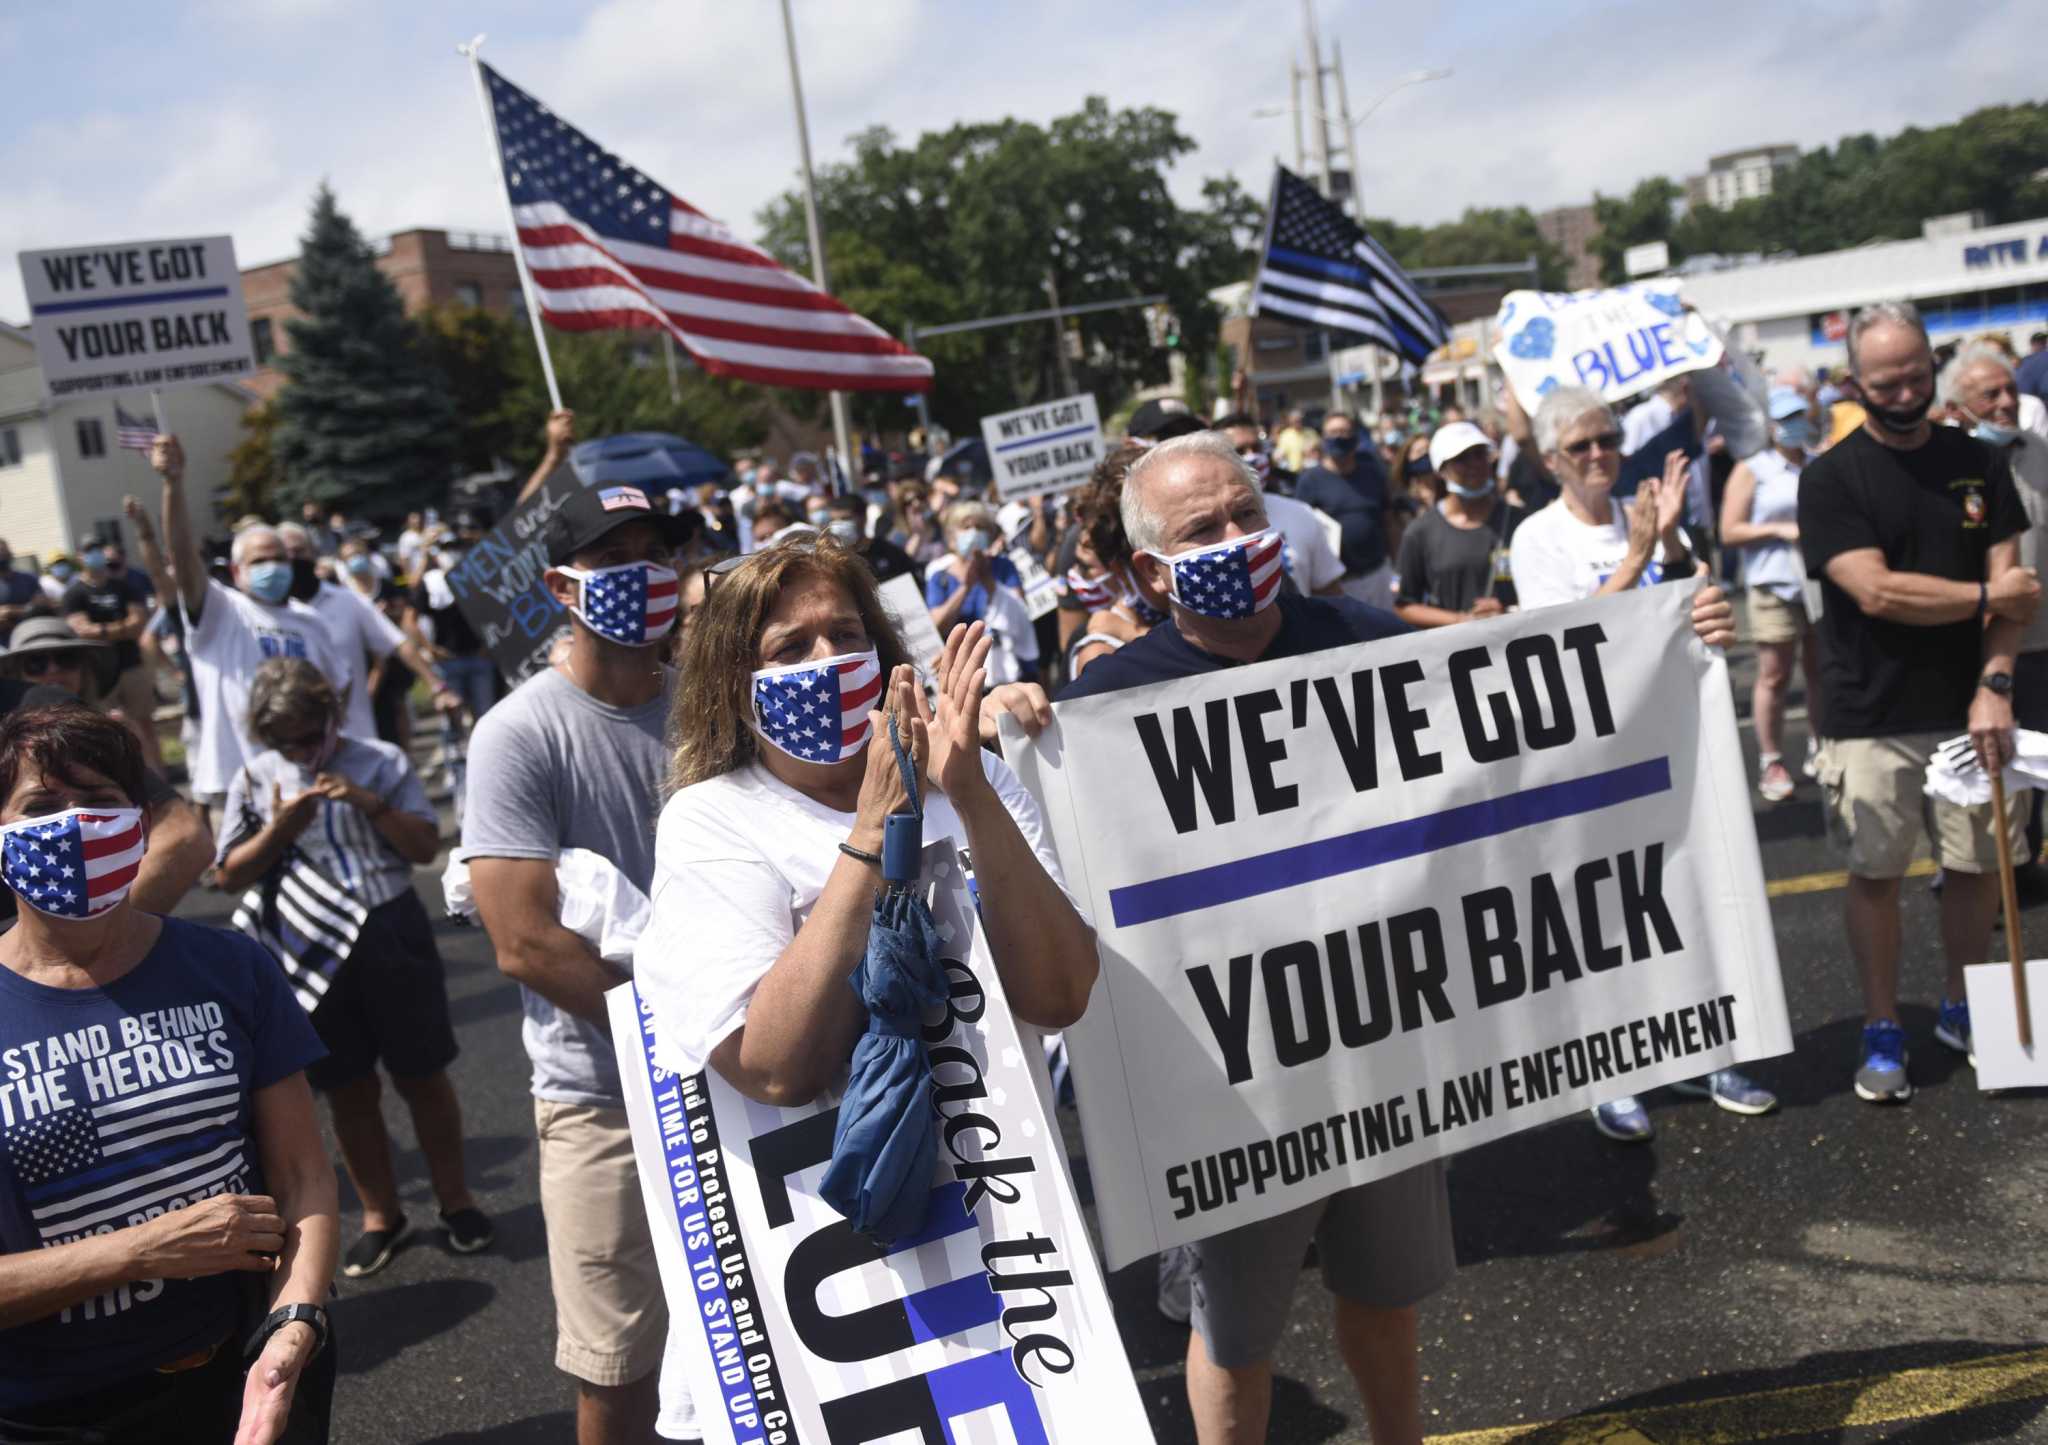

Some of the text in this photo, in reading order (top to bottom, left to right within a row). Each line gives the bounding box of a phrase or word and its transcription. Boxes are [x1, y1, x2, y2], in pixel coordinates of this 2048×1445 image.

[42, 244, 207, 293] WE'VE GOT
[58, 310, 231, 362] YOUR BACK
[1572, 323, 1689, 390] BLUE
[448, 527, 514, 599] MEN
[1133, 623, 1617, 835] WE'VE GOT
[1185, 842, 1685, 1086] YOUR BACK
[2, 1001, 224, 1080] STAND BEHIND
[0, 1030, 235, 1128] THE HEROES
[679, 1072, 706, 1110] nd
[1165, 995, 1738, 1221] SUPPORTING LAW ENFORCEMENT
[657, 1086, 688, 1150] TIME
[690, 1115, 710, 1144] to
[671, 1154, 699, 1208] FOR
[697, 1149, 737, 1249] Protect
[923, 959, 1074, 1389] Back the
[683, 1212, 709, 1250] US
[693, 1255, 719, 1291] TO
[721, 1253, 745, 1290] Us
[704, 1298, 745, 1385] STAND
[732, 1297, 764, 1346] and
[748, 1353, 775, 1400] Our
[730, 1392, 758, 1428] UP
